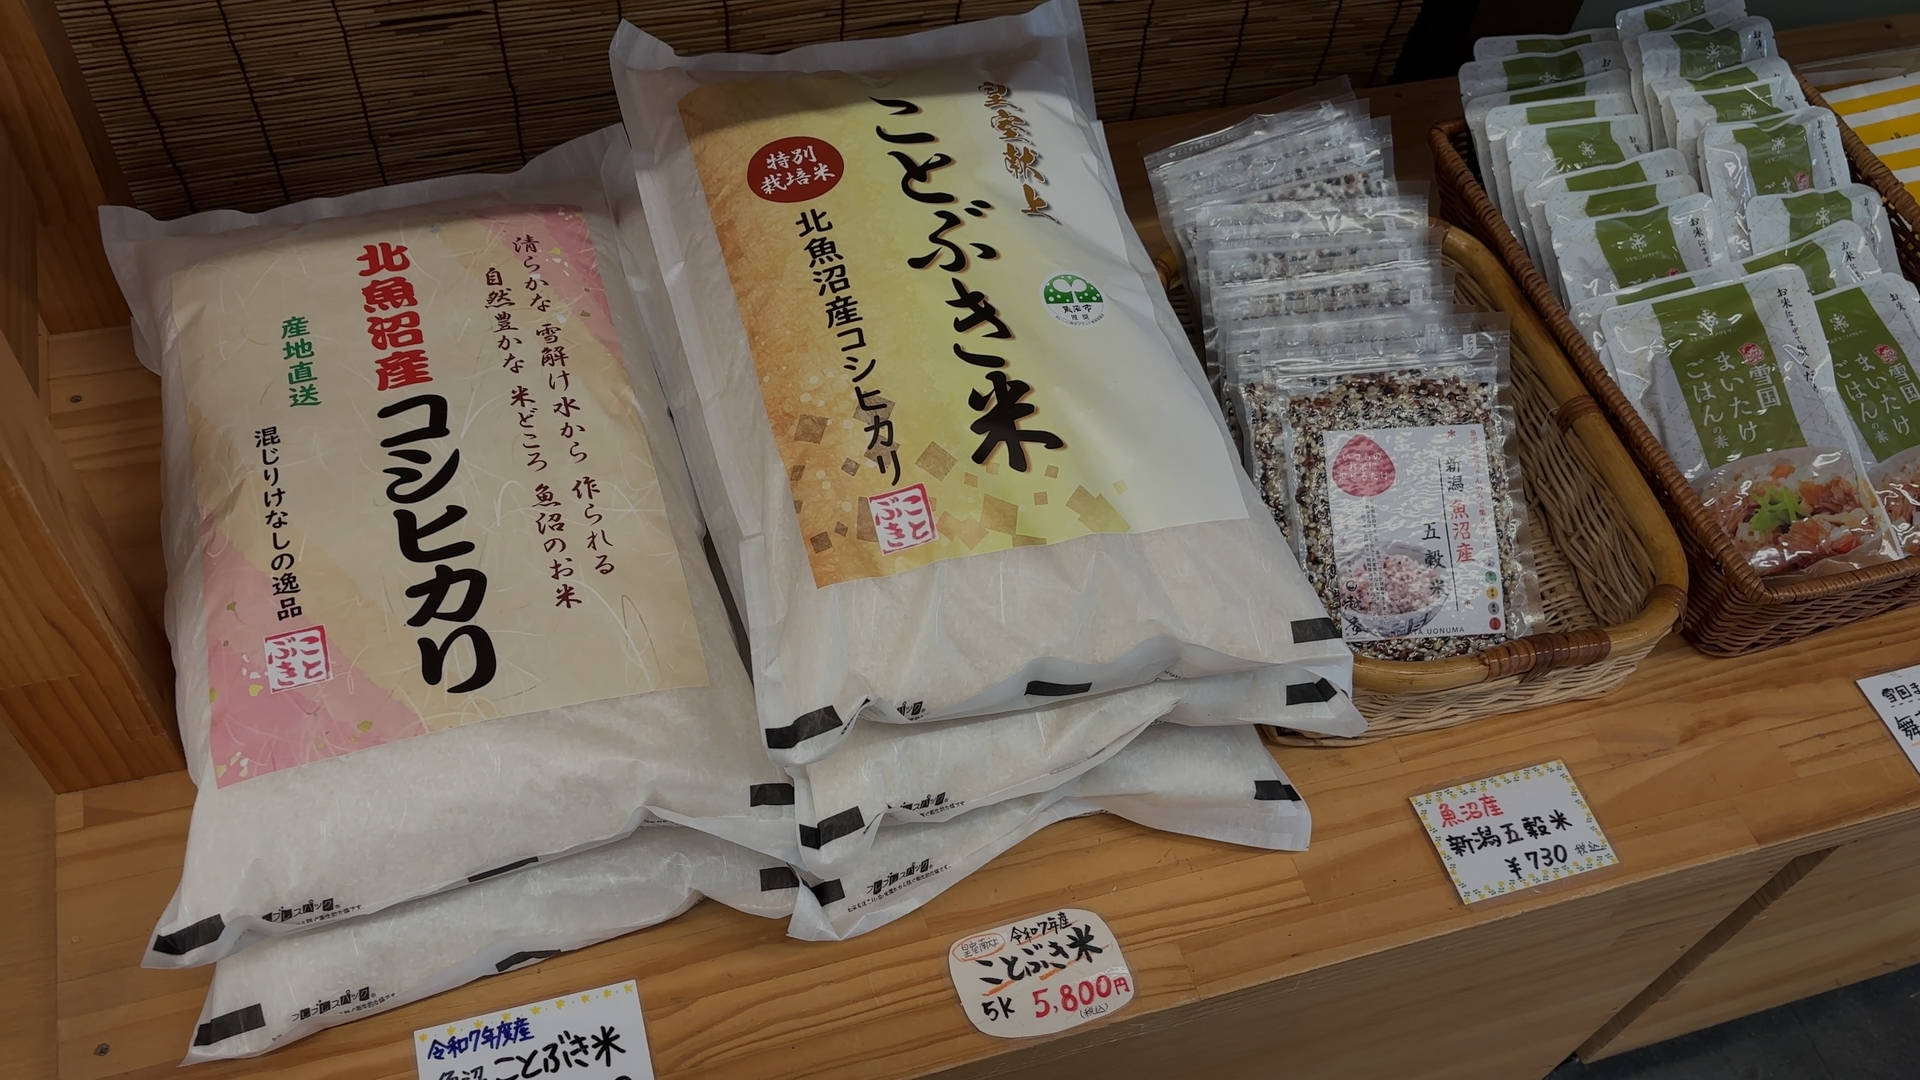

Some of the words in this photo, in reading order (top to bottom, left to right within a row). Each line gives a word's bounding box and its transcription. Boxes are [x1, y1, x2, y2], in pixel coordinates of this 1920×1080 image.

[761, 163, 836, 194] 栽培米
[767, 146, 817, 170] 特別
[978, 82, 1062, 225] 皇室献上
[869, 97, 1067, 472] ことぶき米
[356, 241, 433, 392] 北魚沼産
[281, 315, 322, 408] 産地直送
[795, 208, 903, 487] 北魚沼産コシヒカリ
[511, 234, 552, 313] 清らかな
[570, 476, 615, 576] 作られる
[1713, 351, 1758, 442] まいたけ
[1750, 364, 1782, 410] 雪国
[1855, 353, 1911, 434] まいたけ
[1889, 363, 1920, 404] 雪国
[484, 267, 527, 376] 自然豊かな
[509, 385, 549, 473] 米どころ
[532, 483, 584, 609] 魚沼のお米
[254, 426, 304, 621] 混じりけなしの逸品
[377, 393, 497, 694] コシヒカリ
[1449, 500, 1474, 562] 魚沼産
[1427, 626, 1465, 635] UONUMA
[1894, 710, 1920, 740] 舞
[1439, 794, 1503, 828] 魚沼産
[1446, 809, 1573, 857] 新潟五穀米
[976, 924, 1104, 984] ことぶき米
[1010, 912, 1073, 945] 令和7年産
[1032, 974, 1131, 1018] 5,800円
[427, 1017, 535, 1060] 令和7年度産
[494, 1025, 627, 1080] ことぶき米
